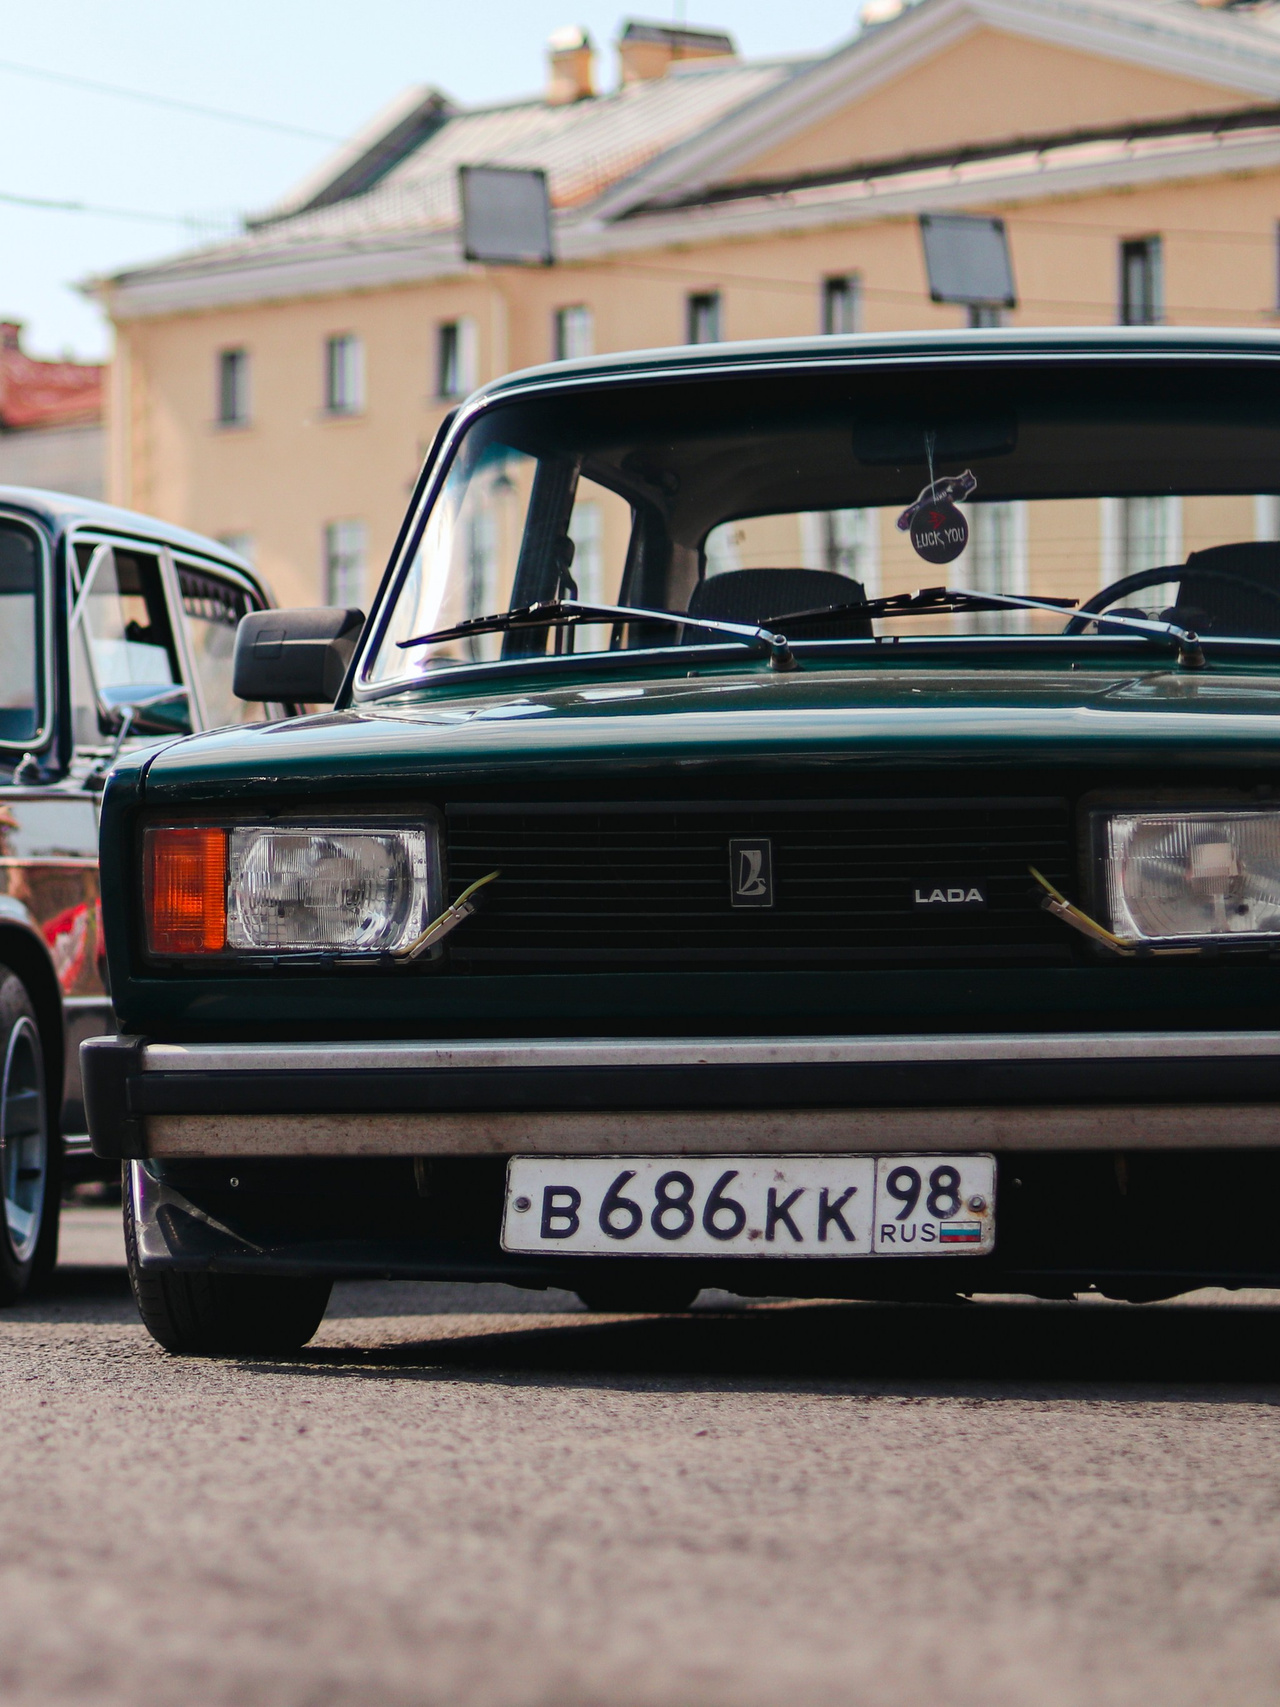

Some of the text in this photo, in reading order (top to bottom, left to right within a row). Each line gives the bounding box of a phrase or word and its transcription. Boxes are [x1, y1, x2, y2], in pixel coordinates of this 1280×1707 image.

[915, 527, 965, 549] LUCK YOU
[914, 888, 984, 903] LADA
[886, 1165, 962, 1221] 98
[880, 1223, 936, 1243] RUS
